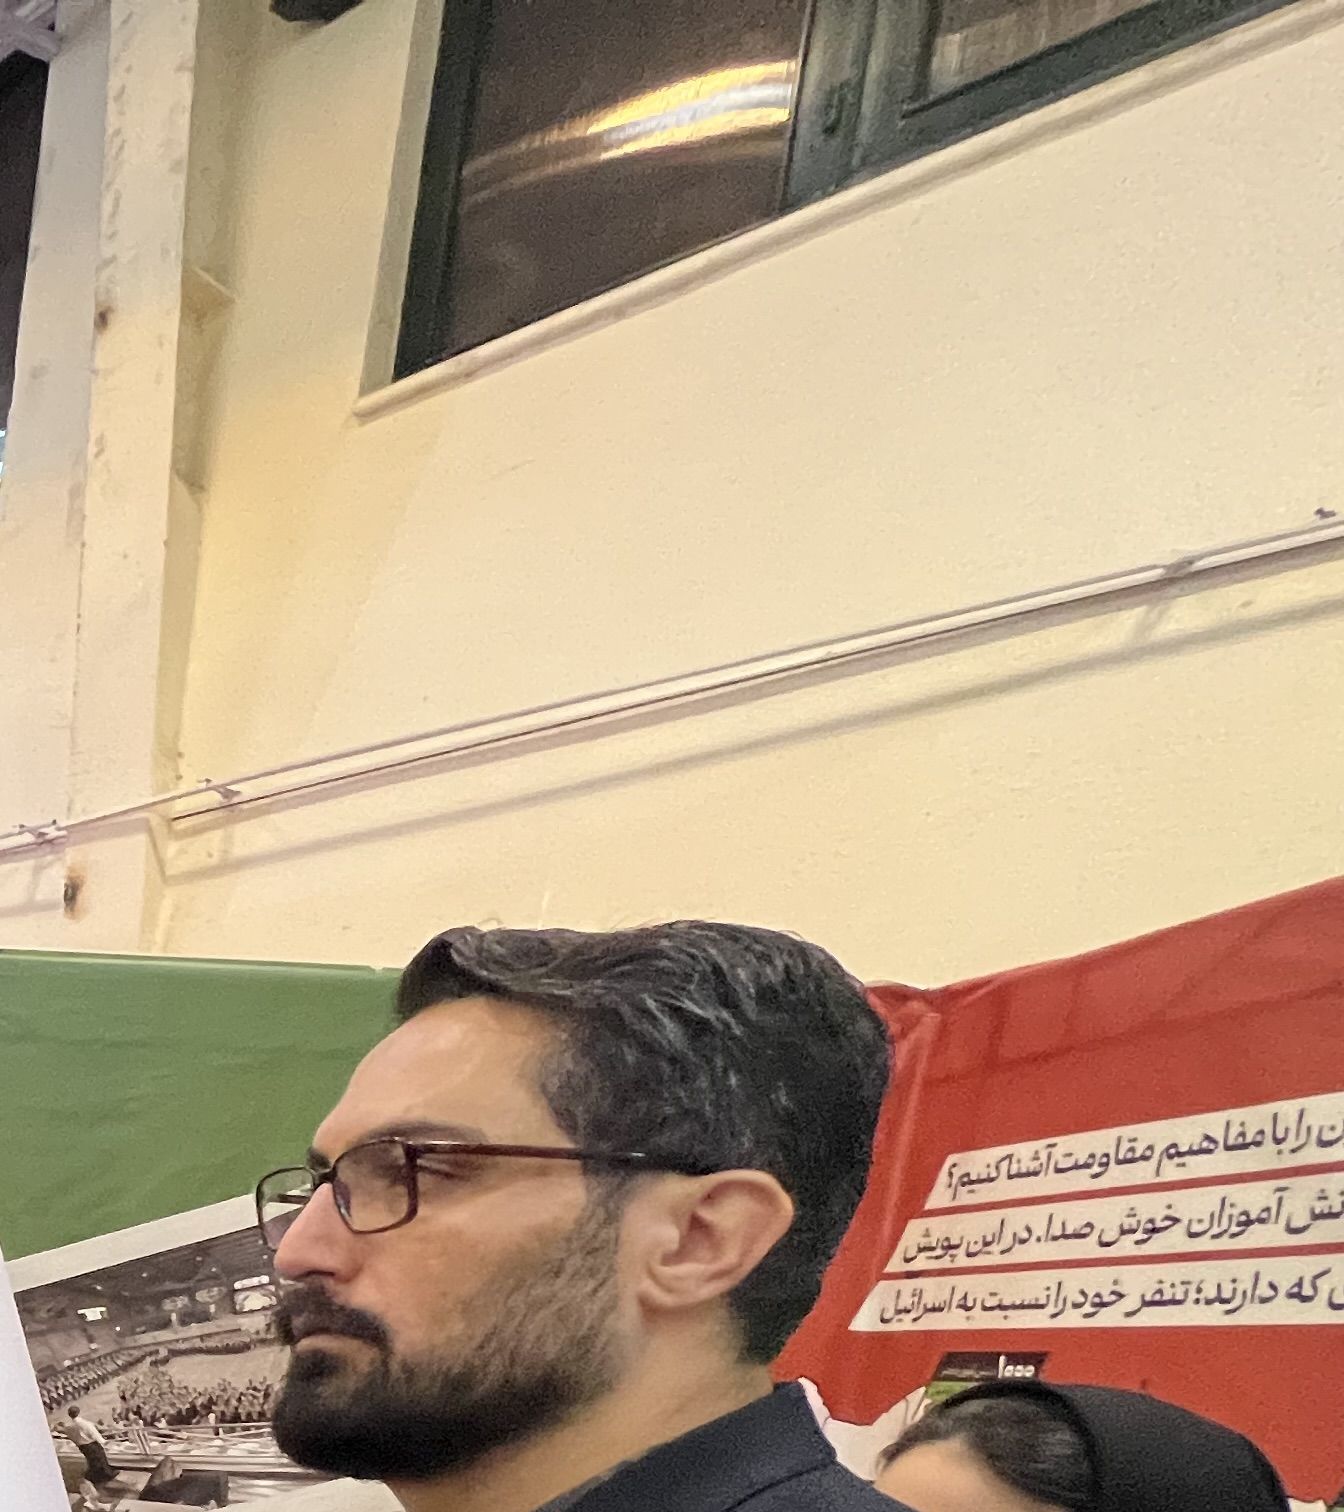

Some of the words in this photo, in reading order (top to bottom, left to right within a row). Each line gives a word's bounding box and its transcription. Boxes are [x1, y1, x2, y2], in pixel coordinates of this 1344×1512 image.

[1053, 1134, 1155, 1180] مقاومت
[1155, 1119, 1266, 1178] مفاهیم
[965, 1217, 1006, 1258] این
[1000, 1223, 1033, 1255] در
[1097, 1203, 1182, 1248] خوش
[879, 1286, 956, 1324] اسرائیل
[980, 1286, 1051, 1320] نسبت
[1071, 1278, 1129, 1319] خود
[1123, 1278, 1193, 1318] تنفر
[1285, 1267, 1332, 1304] که
[955, 1291, 977, 1321] به
